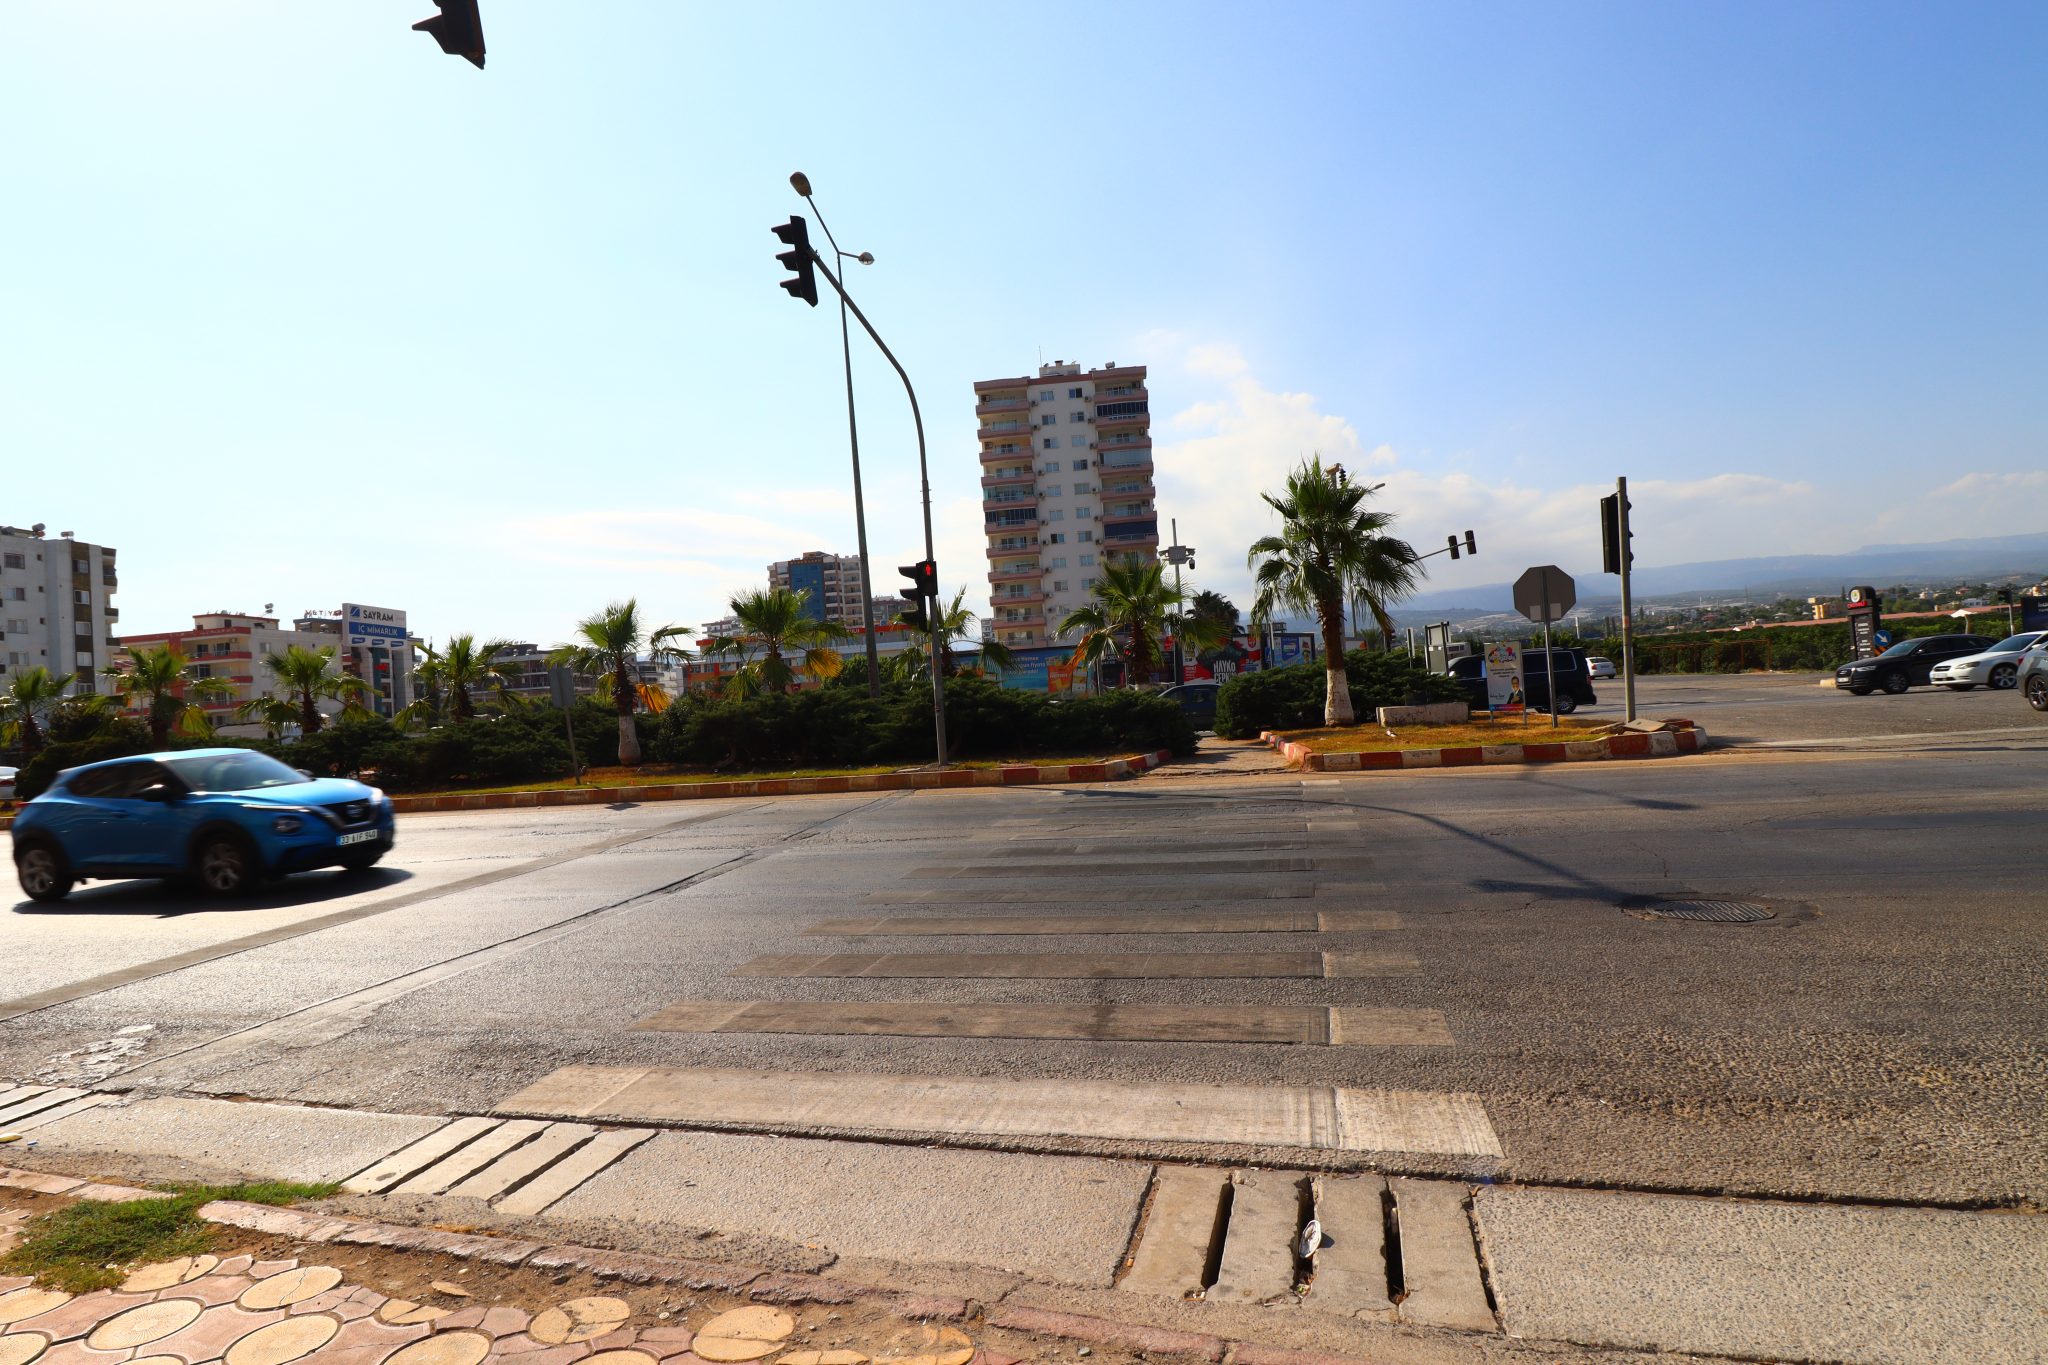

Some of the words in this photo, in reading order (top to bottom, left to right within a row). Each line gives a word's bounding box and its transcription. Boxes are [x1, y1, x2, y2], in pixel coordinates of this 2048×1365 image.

[363, 610, 394, 621] SAYRAM
[358, 624, 365, 633] İÇ
[367, 625, 398, 636] MİMARLIK
[1213, 660, 1236, 673] HAYKO
[1214, 672, 1237, 684] CEPK
